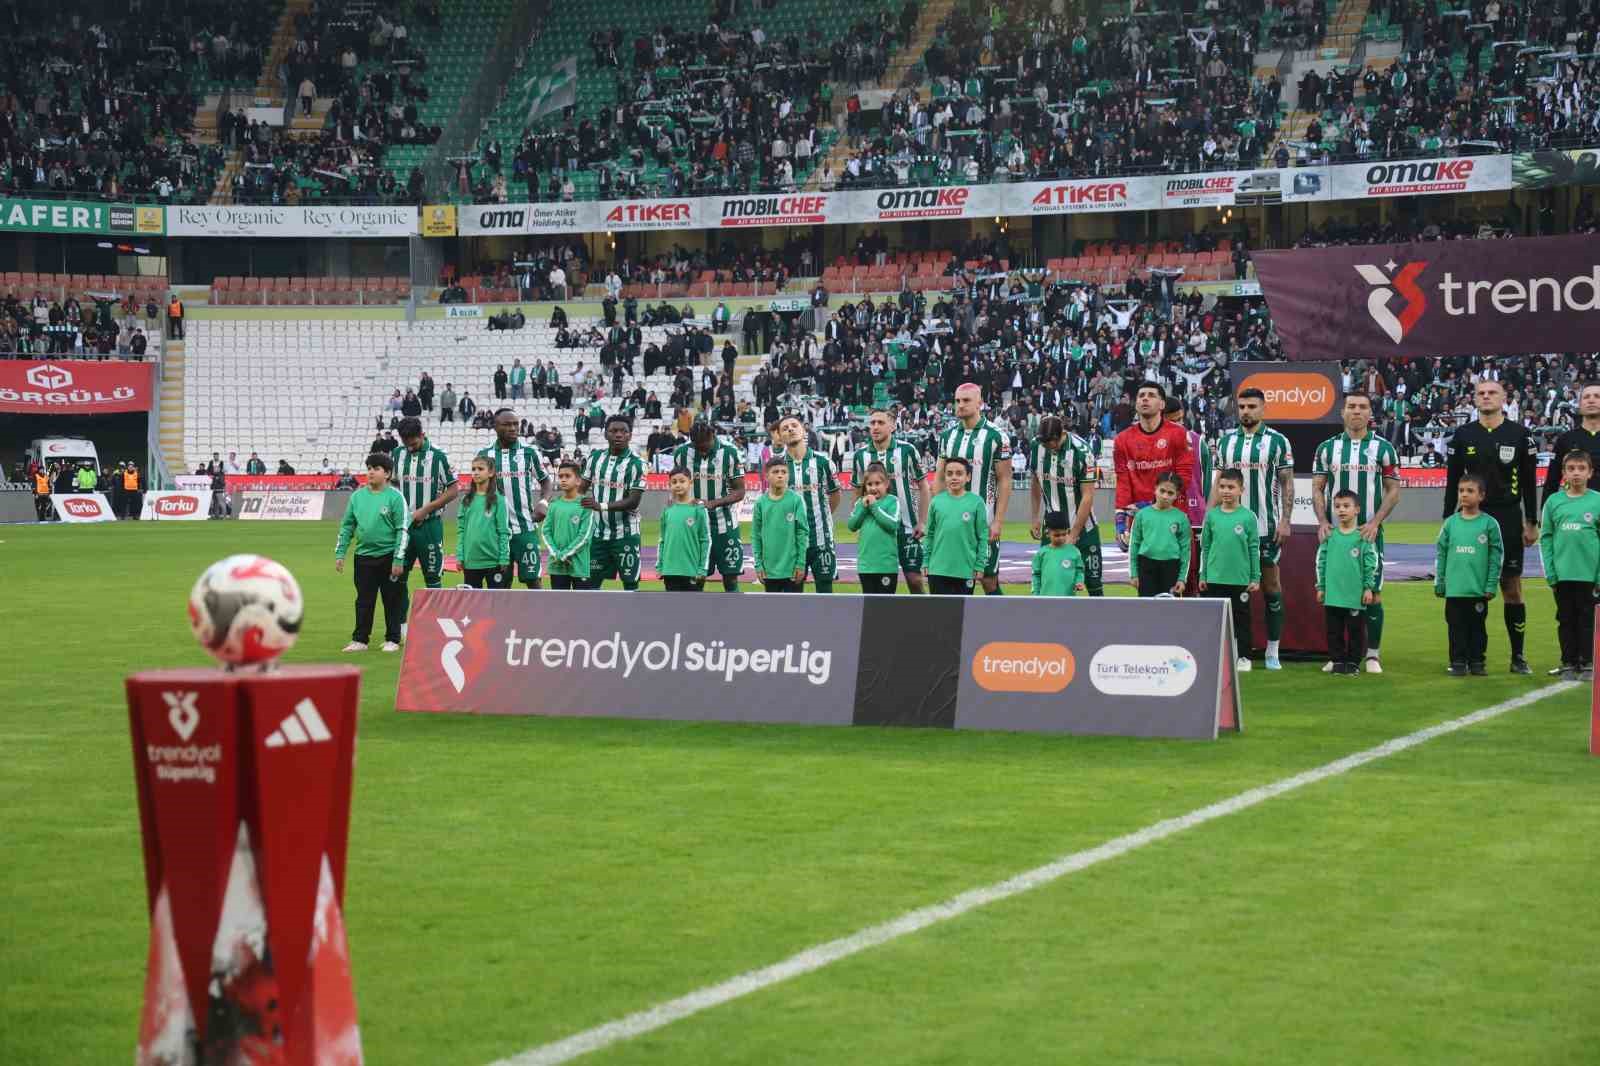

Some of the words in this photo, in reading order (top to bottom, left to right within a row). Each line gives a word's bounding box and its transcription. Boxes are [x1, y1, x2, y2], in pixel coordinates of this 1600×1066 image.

[722, 197, 826, 216] MOBILCHEF
[0, 204, 102, 229] AFER!
[179, 208, 211, 228] Rey
[216, 208, 284, 230] Organic
[303, 208, 336, 228] Rey
[340, 208, 408, 230] Organic
[1438, 264, 1600, 316] trend
[450, 306, 458, 317] A
[65, 502, 97, 513] Torku
[159, 500, 194, 512] Torku
[428, 552, 437, 565] 5
[522, 552, 537, 565] 40
[619, 553, 634, 568] 70
[725, 548, 740, 561] 23
[819, 553, 832, 566] 10
[1086, 555, 1100, 568] 18
[505, 630, 681, 678] trendyol
[685, 641, 832, 685] SüperLig
[983, 655, 1065, 680] trendyol
[1097, 664, 1119, 673] Türk
[1123, 664, 1169, 675] Telekom
[147, 744, 222, 766] trendyol
